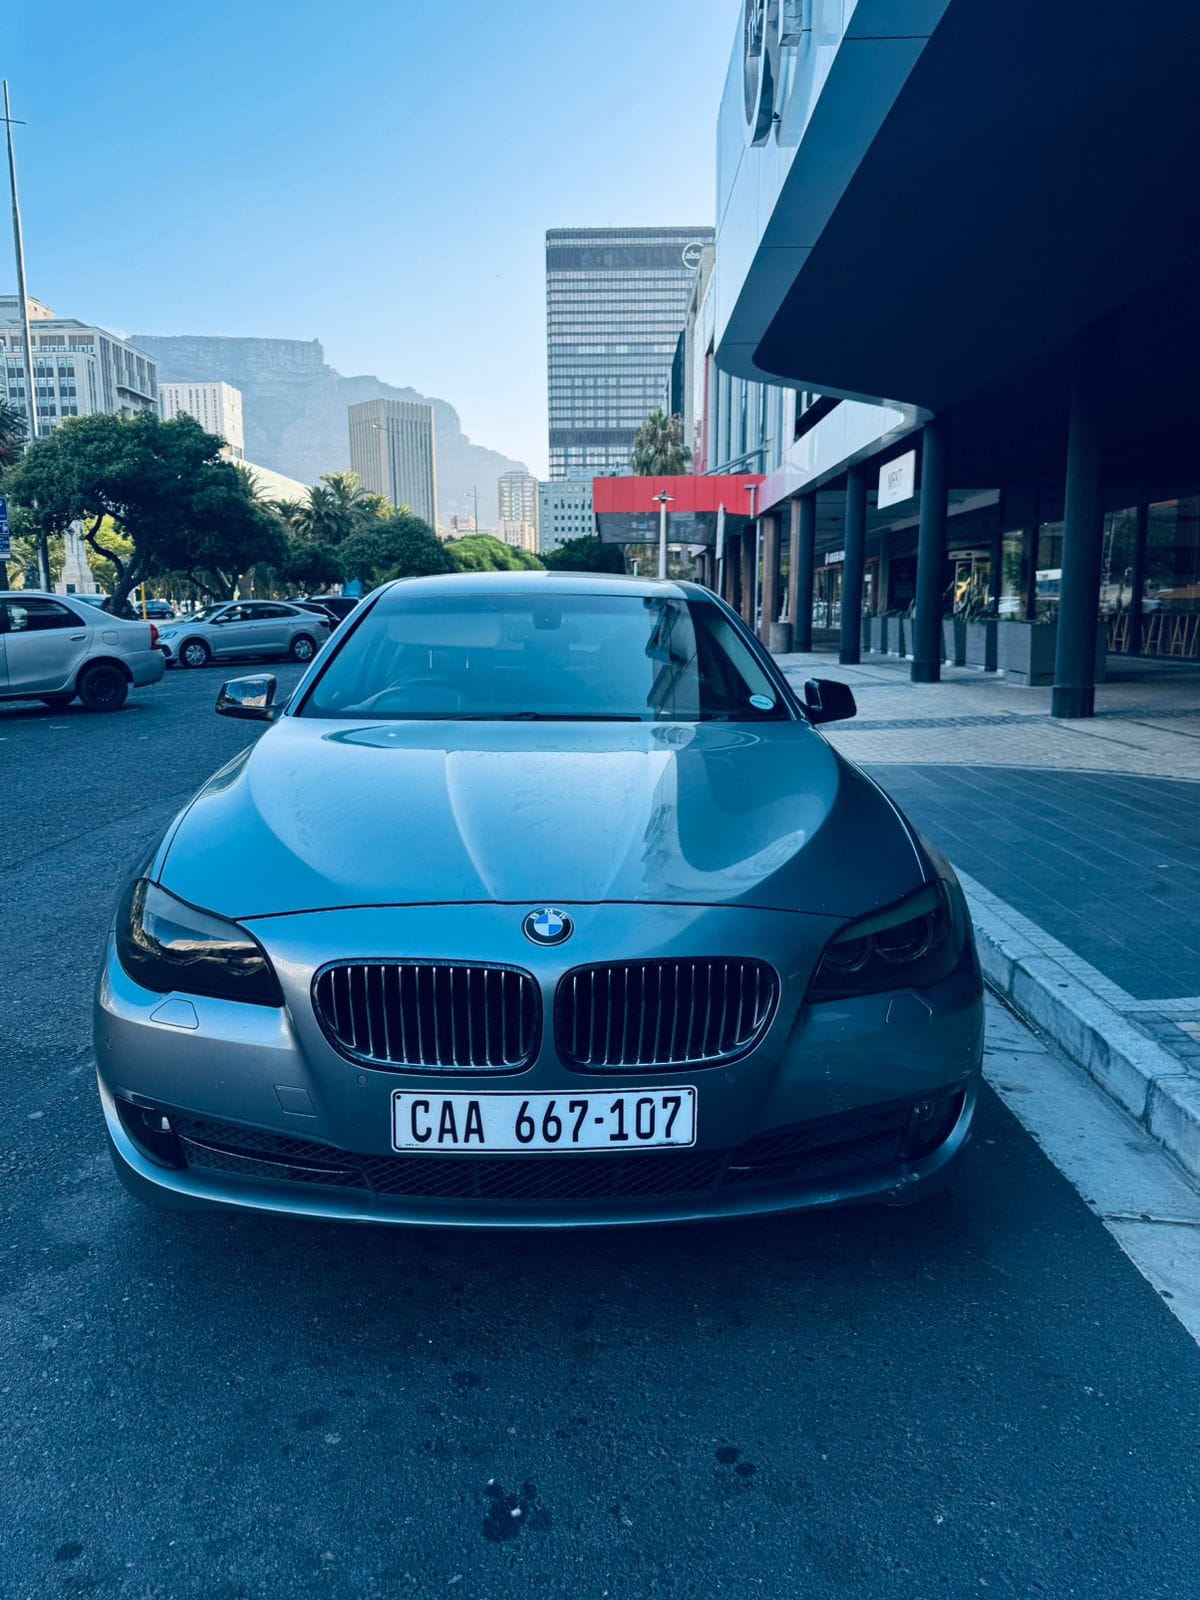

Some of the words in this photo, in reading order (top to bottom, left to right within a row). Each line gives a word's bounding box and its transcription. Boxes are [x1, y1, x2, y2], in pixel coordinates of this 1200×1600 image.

[685, 250, 701, 260] abs
[529, 908, 569, 920] BMW
[411, 1099, 485, 1144] CAA
[514, 1096, 682, 1144] 667-107
